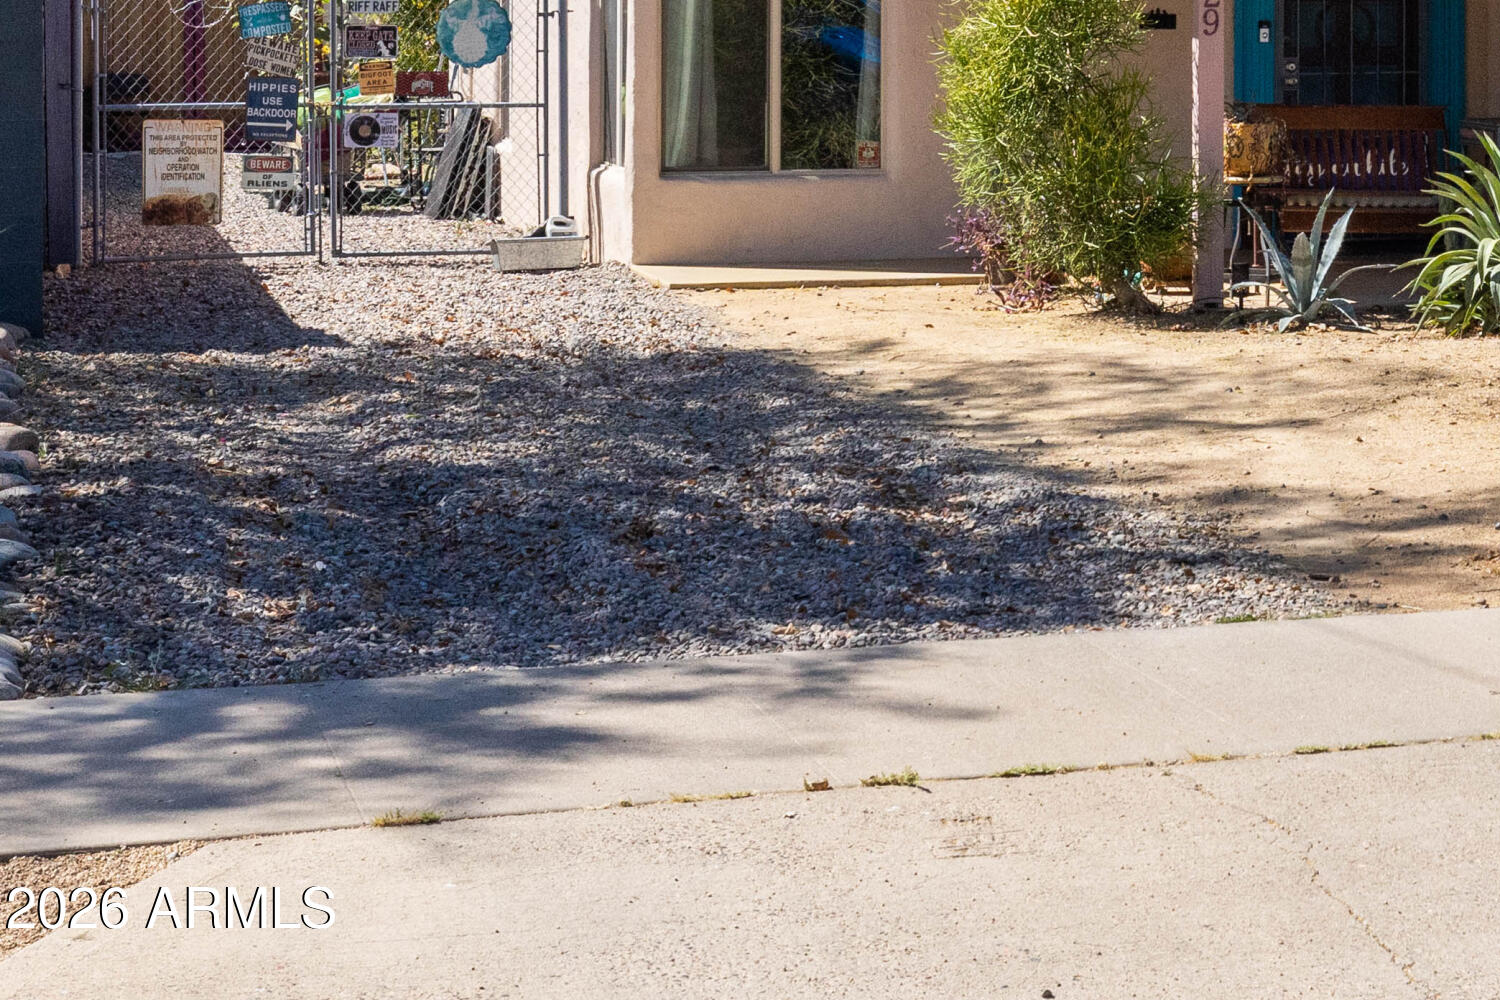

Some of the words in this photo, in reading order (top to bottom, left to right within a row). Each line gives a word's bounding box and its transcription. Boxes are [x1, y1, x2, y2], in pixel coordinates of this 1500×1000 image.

[348, 1, 370, 12] RIFF
[373, 1, 398, 12] RAFF
[242, 23, 292, 39] COMPOSTED
[348, 30, 371, 41] KEEP
[372, 30, 394, 41] GATE
[248, 43, 298, 65] PICKPOCKETS
[270, 62, 297, 77] WOMEN
[360, 71, 392, 79] BIGFOOT
[248, 82, 297, 93] HIPPIES
[262, 96, 283, 106] USE
[247, 107, 297, 119] BACKDOOR
[148, 147, 196, 155] NEIGHBORHOOD
[197, 147, 218, 155] WATCH
[166, 163, 200, 171] OPERATION
[250, 159, 287, 169] BEWARE
[161, 172, 206, 180] IDENTIFICATION
[247, 180, 288, 188] ALIENS
